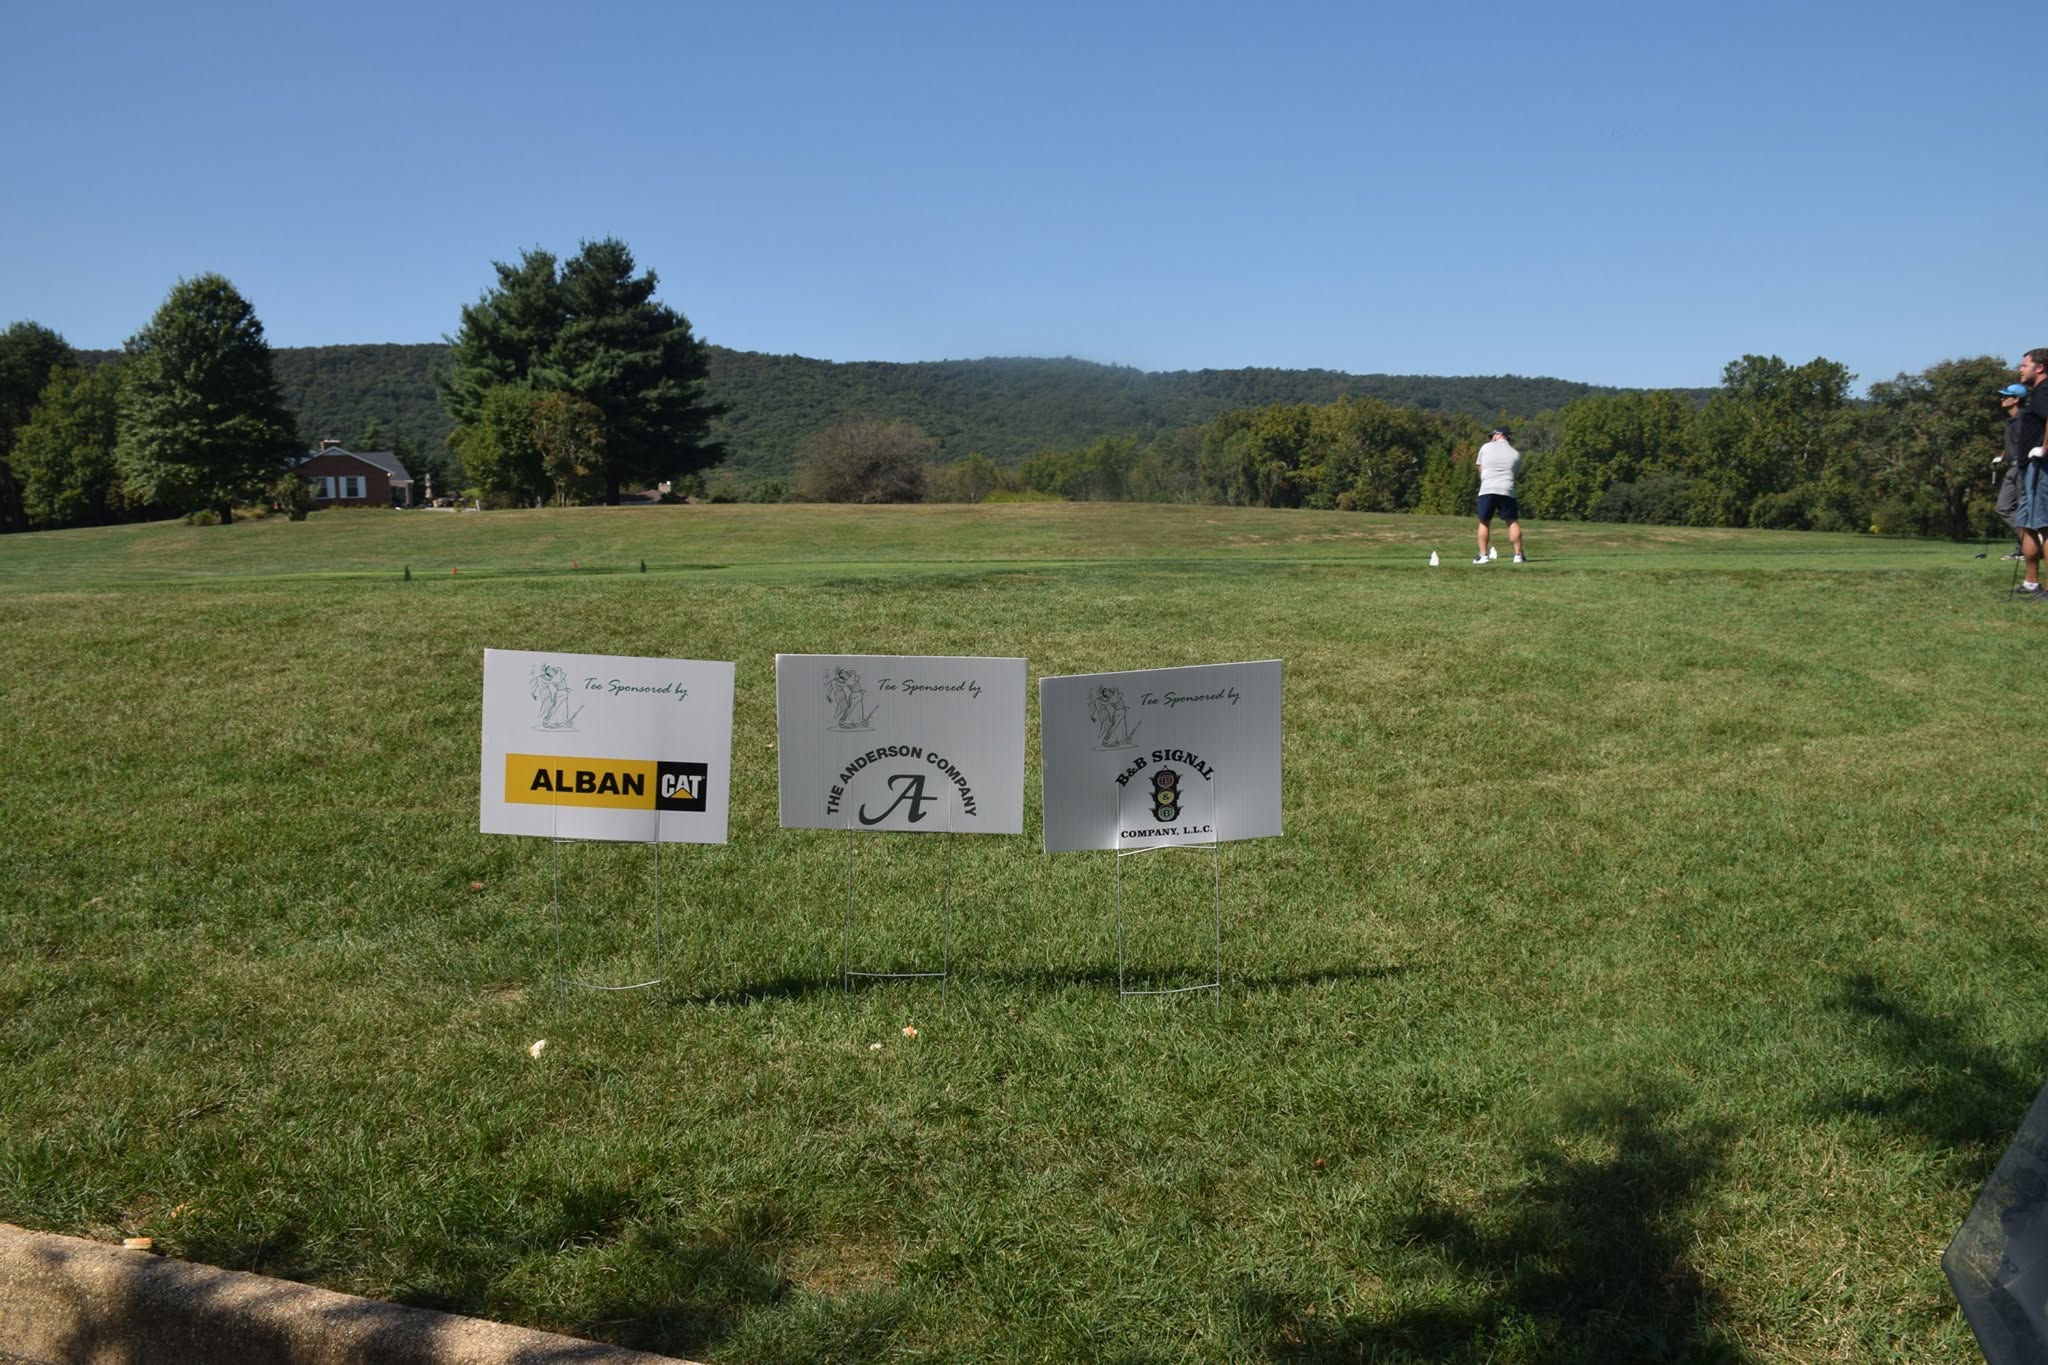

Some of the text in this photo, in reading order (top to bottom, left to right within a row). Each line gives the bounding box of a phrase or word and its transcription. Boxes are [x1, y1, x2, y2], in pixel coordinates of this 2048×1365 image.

[584, 677, 689, 701] Tee Sponsored by
[878, 678, 982, 698] Tee Sponsored by
[1140, 687, 1241, 708] Tee Sponsored by
[827, 745, 977, 817] THE ANDERSON COMPANY
[1115, 749, 1215, 787] B&B SIGNAL
[530, 768, 645, 796] ALBAN
[661, 773, 703, 800] CAT
[858, 774, 938, 826] A
[1183, 825, 1213, 835] L.L.C.
